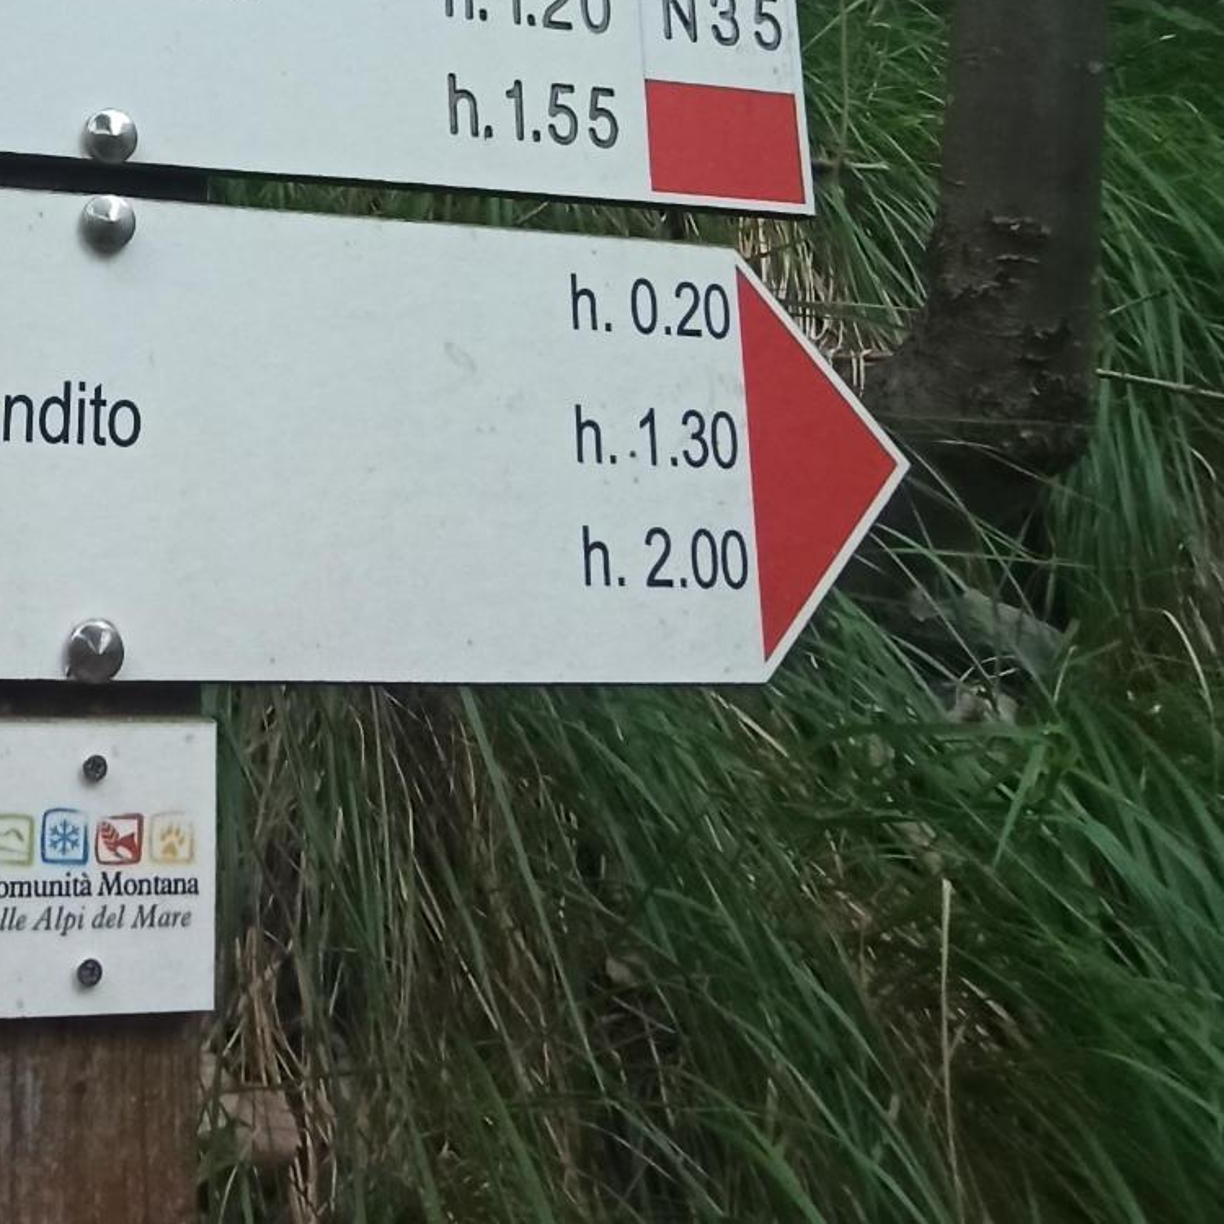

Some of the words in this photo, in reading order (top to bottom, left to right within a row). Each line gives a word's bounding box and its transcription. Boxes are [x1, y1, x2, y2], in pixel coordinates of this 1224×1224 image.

[448, 73, 619, 149] h.1.55
[571, 273, 612, 332] h.
[631, 278, 730, 339] 0.20
[575, 404, 616, 464] h.
[638, 408, 737, 469] 1.30
[583, 526, 625, 586] h.
[645, 527, 748, 590] 2.00
[98, 872, 199, 896] Montana
[32, 906, 86, 936] Alpi
[92, 904, 124, 929] del
[129, 904, 192, 928] Mare
